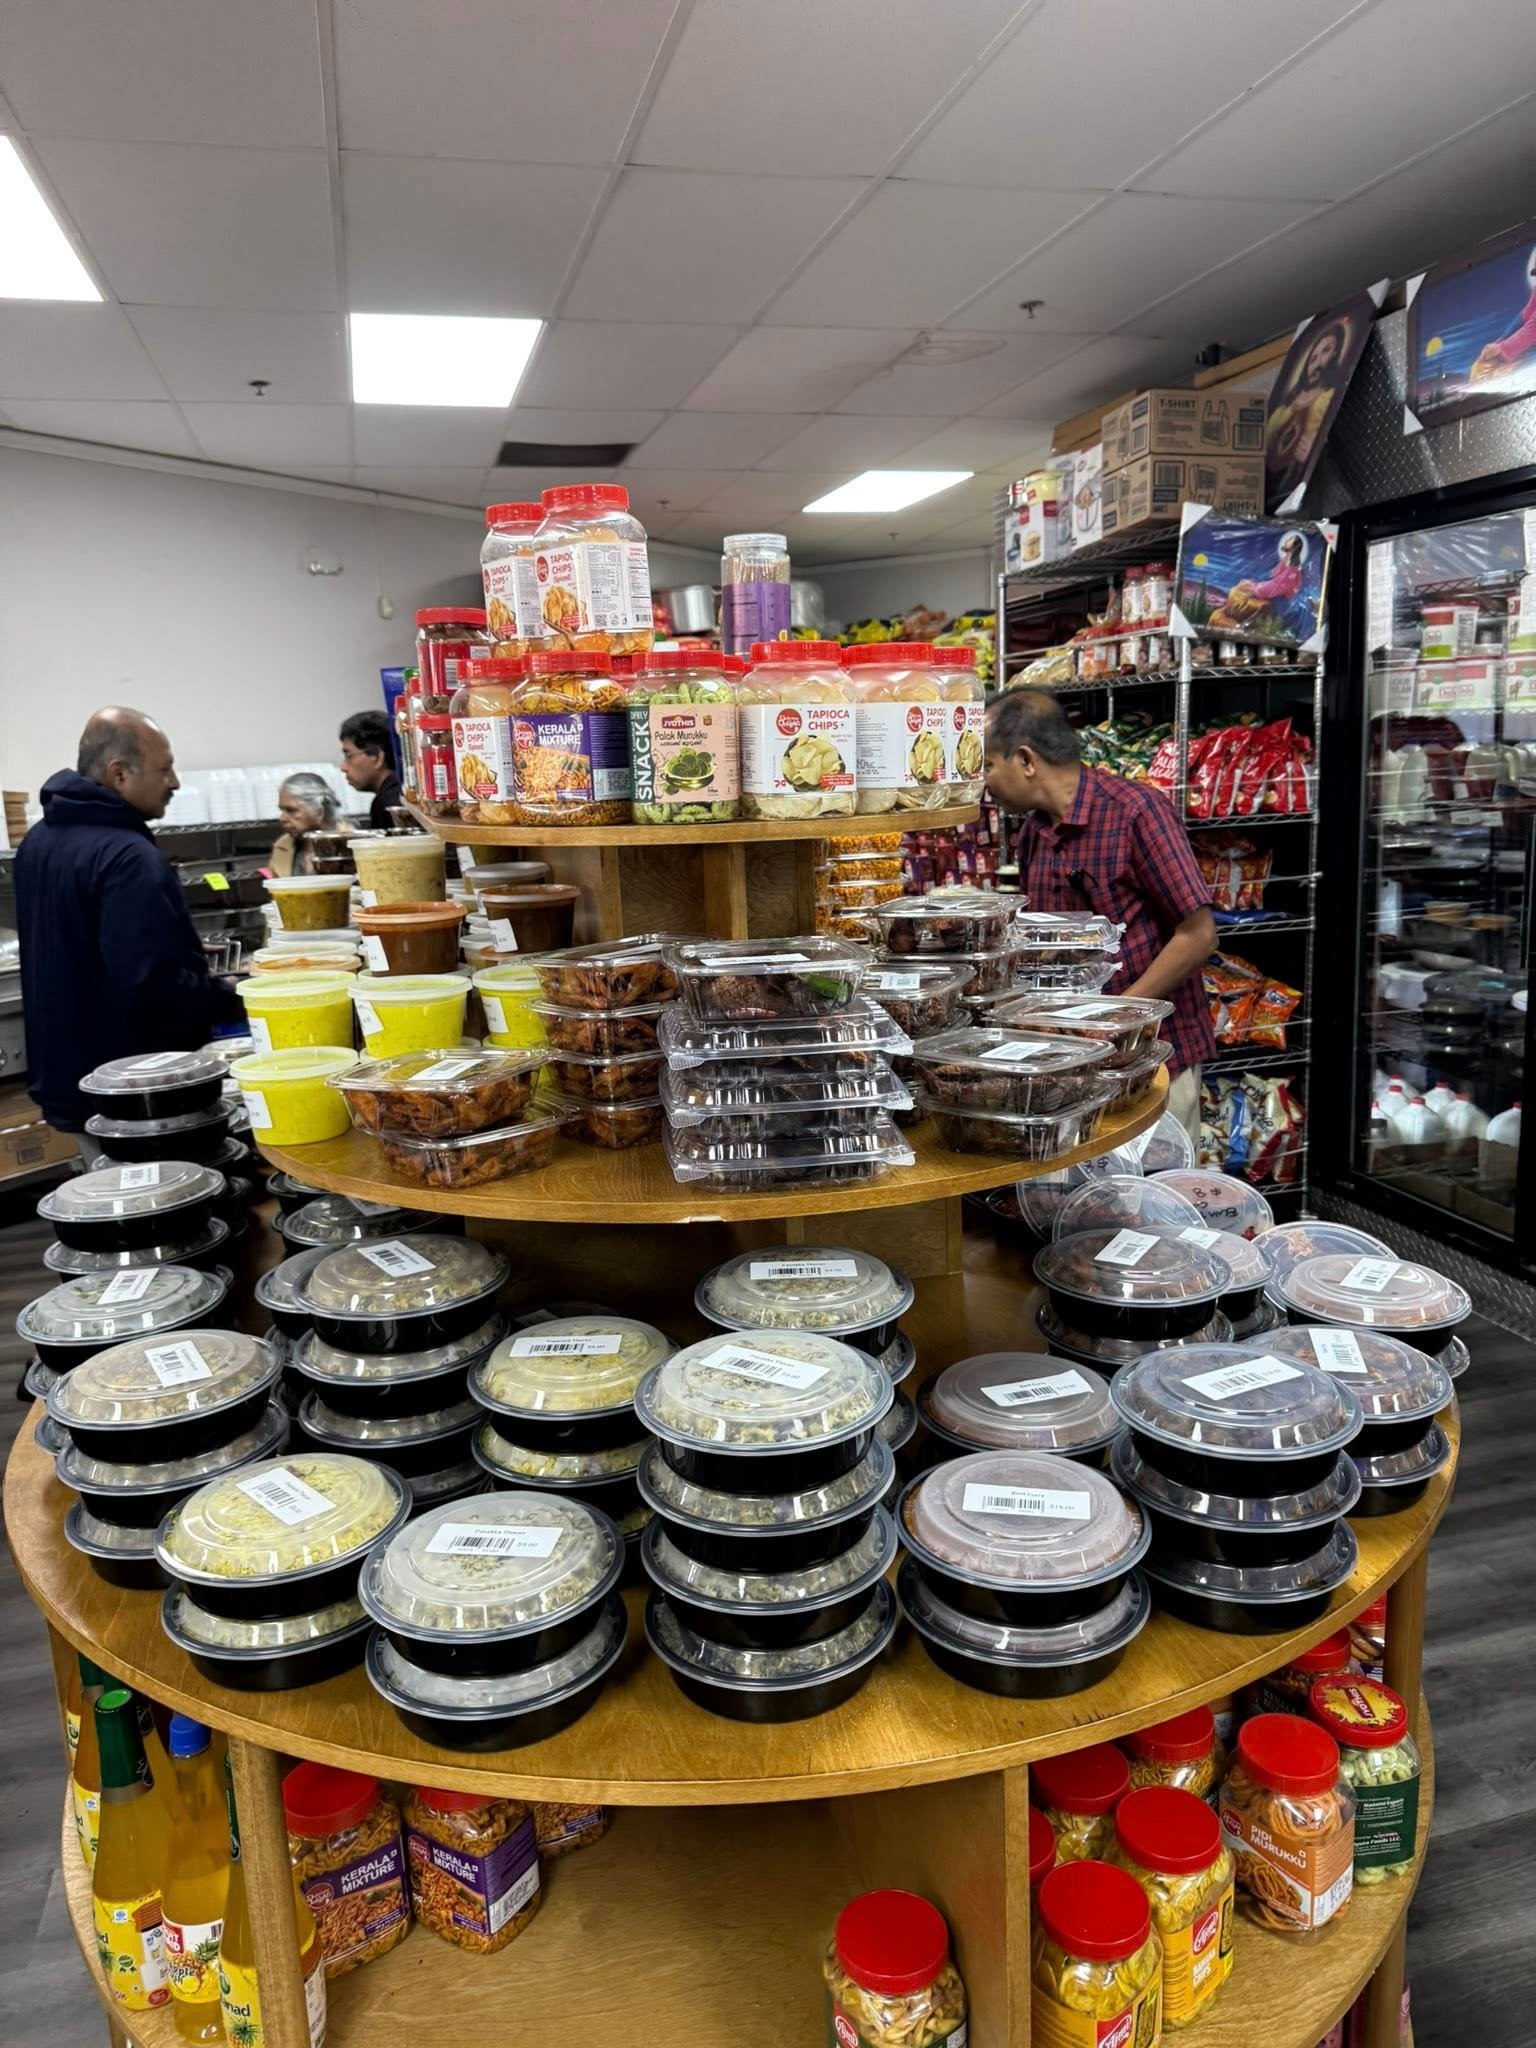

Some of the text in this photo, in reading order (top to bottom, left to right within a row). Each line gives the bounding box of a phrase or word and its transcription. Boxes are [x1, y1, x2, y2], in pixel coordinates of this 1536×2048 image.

[550, 551, 574, 562] TAPIOC
[490, 564, 511, 575] TAPIOCA
[551, 563, 573, 574] CHIPS
[491, 577, 506, 587] CHIPS
[630, 710, 648, 720] DAILY
[807, 710, 850, 719] TAPIOCA
[926, 708, 946, 716] TAPIOC
[465, 722, 491, 732] TAPIOCA
[663, 719, 695, 727] JYOTHIS
[808, 721, 838, 730] CHIPS
[926, 718, 944, 727] CHIPS
[537, 725, 576, 735] KERALA
[676, 730, 708, 741] Murukku
[466, 734, 484, 744] CHIPS
[539, 734, 581, 745] MIXTURE
[635, 721, 653, 801] SNACK
[1348, 1687, 1373, 1718] JYOTHIS
[1251, 1825, 1272, 1843] PIDI
[1251, 1834, 1307, 1869] MURUKKU
[432, 1847, 472, 1873] KERALA
[341, 1855, 391, 1885] KERALA
[434, 1855, 477, 1883] MIXTURE
[342, 1861, 396, 1894] MIXTURE
